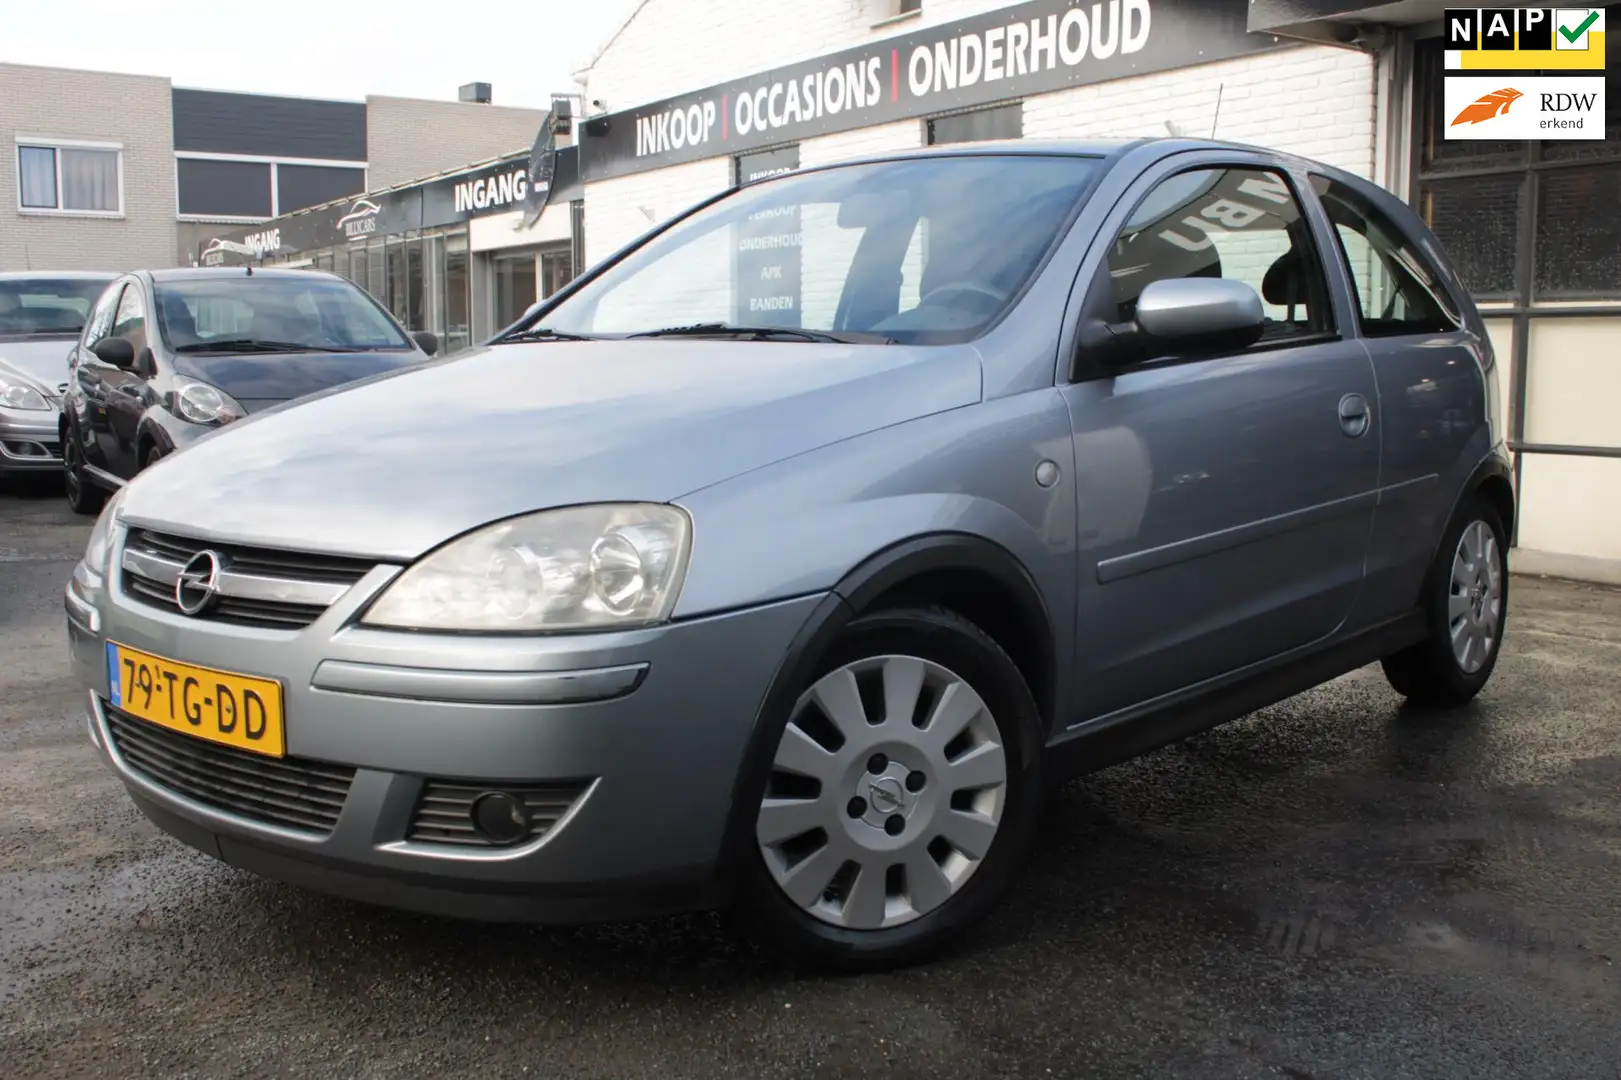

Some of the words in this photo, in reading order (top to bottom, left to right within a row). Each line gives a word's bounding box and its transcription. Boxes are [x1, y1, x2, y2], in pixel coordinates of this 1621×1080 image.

[636, 100, 715, 157] INKOOP
[734, 56, 881, 136] OCCASIONS
[908, 0, 1151, 97] ONDERHOUD
[455, 169, 526, 213] INGANG
[760, 265, 783, 280] APK
[749, 296, 794, 311] BANDEN
[124, 658, 267, 740] 79-TG-DD
